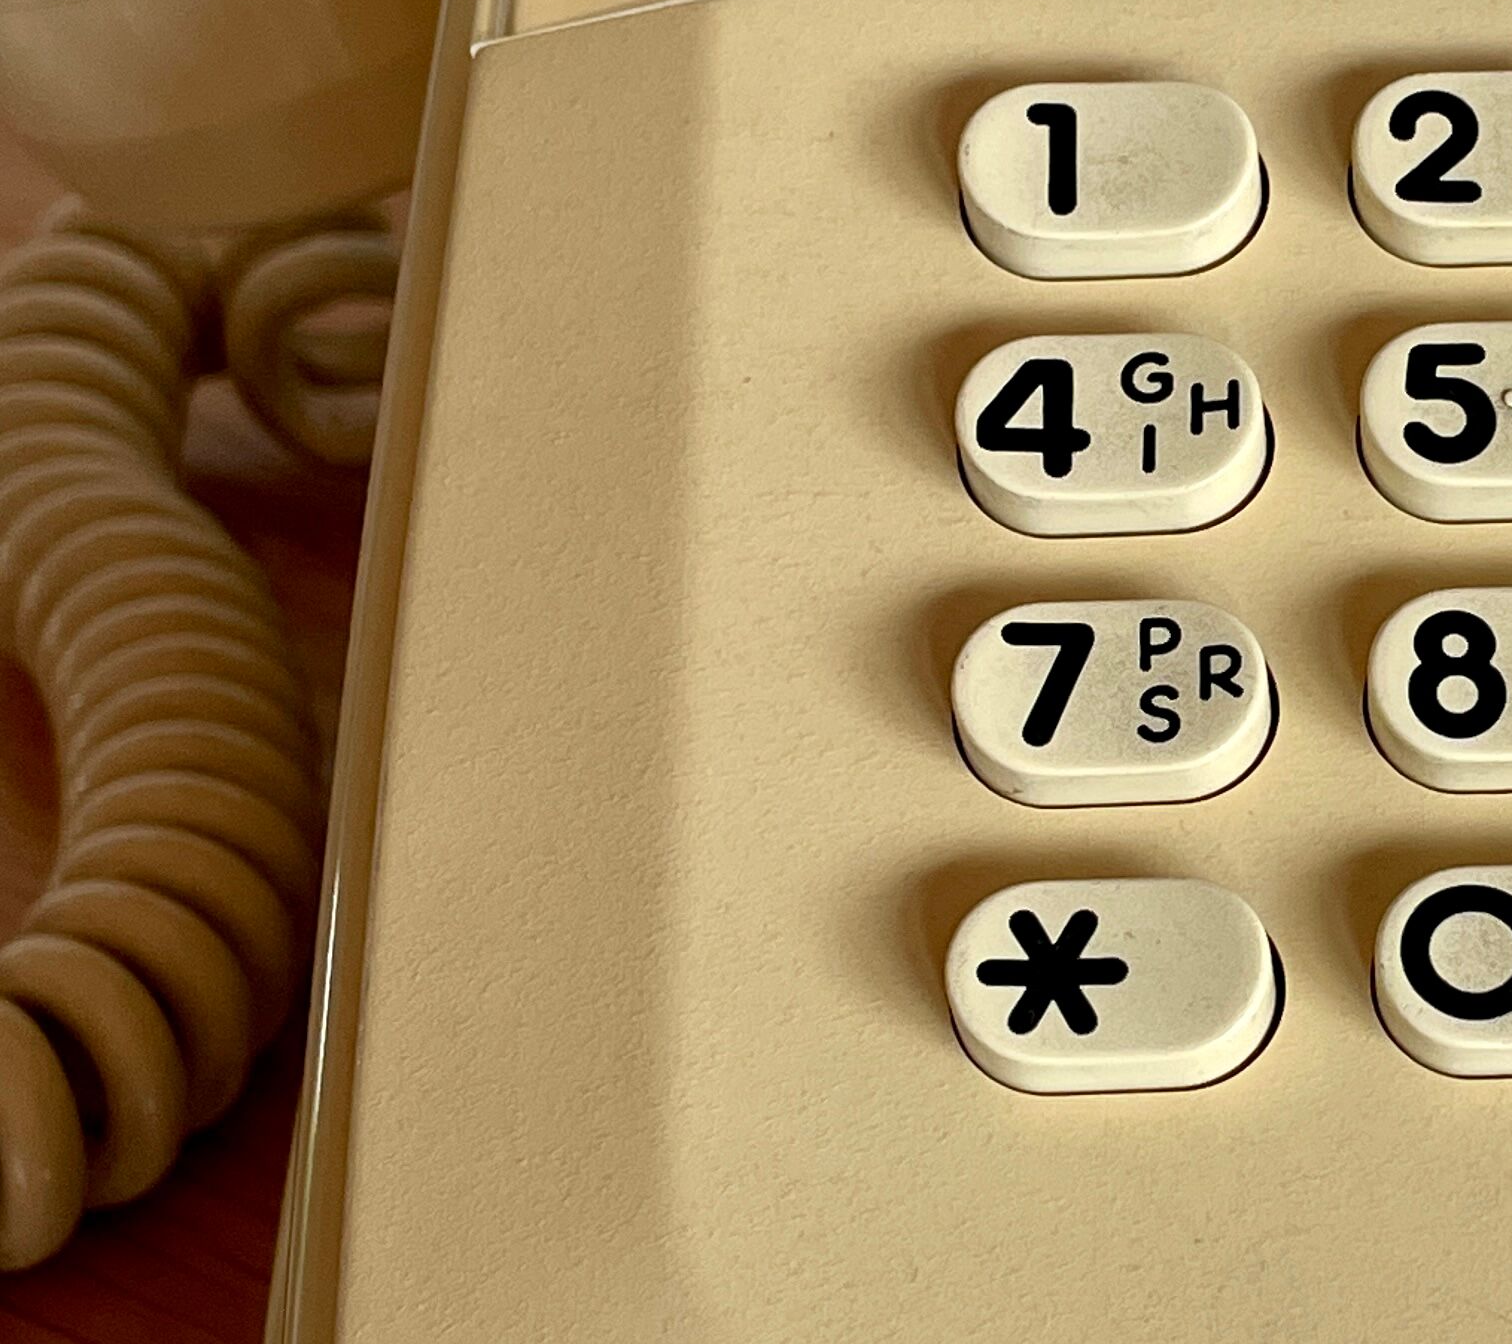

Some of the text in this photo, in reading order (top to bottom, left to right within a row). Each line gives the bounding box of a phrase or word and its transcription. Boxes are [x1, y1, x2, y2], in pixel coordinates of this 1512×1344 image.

[1026, 102, 1078, 216] 1
[1388, 89, 1483, 204] 2
[975, 358, 1092, 479] 4
[1403, 342, 1498, 465] 5
[1000, 621, 1096, 748] 7
[1407, 609, 1507, 740] 8
